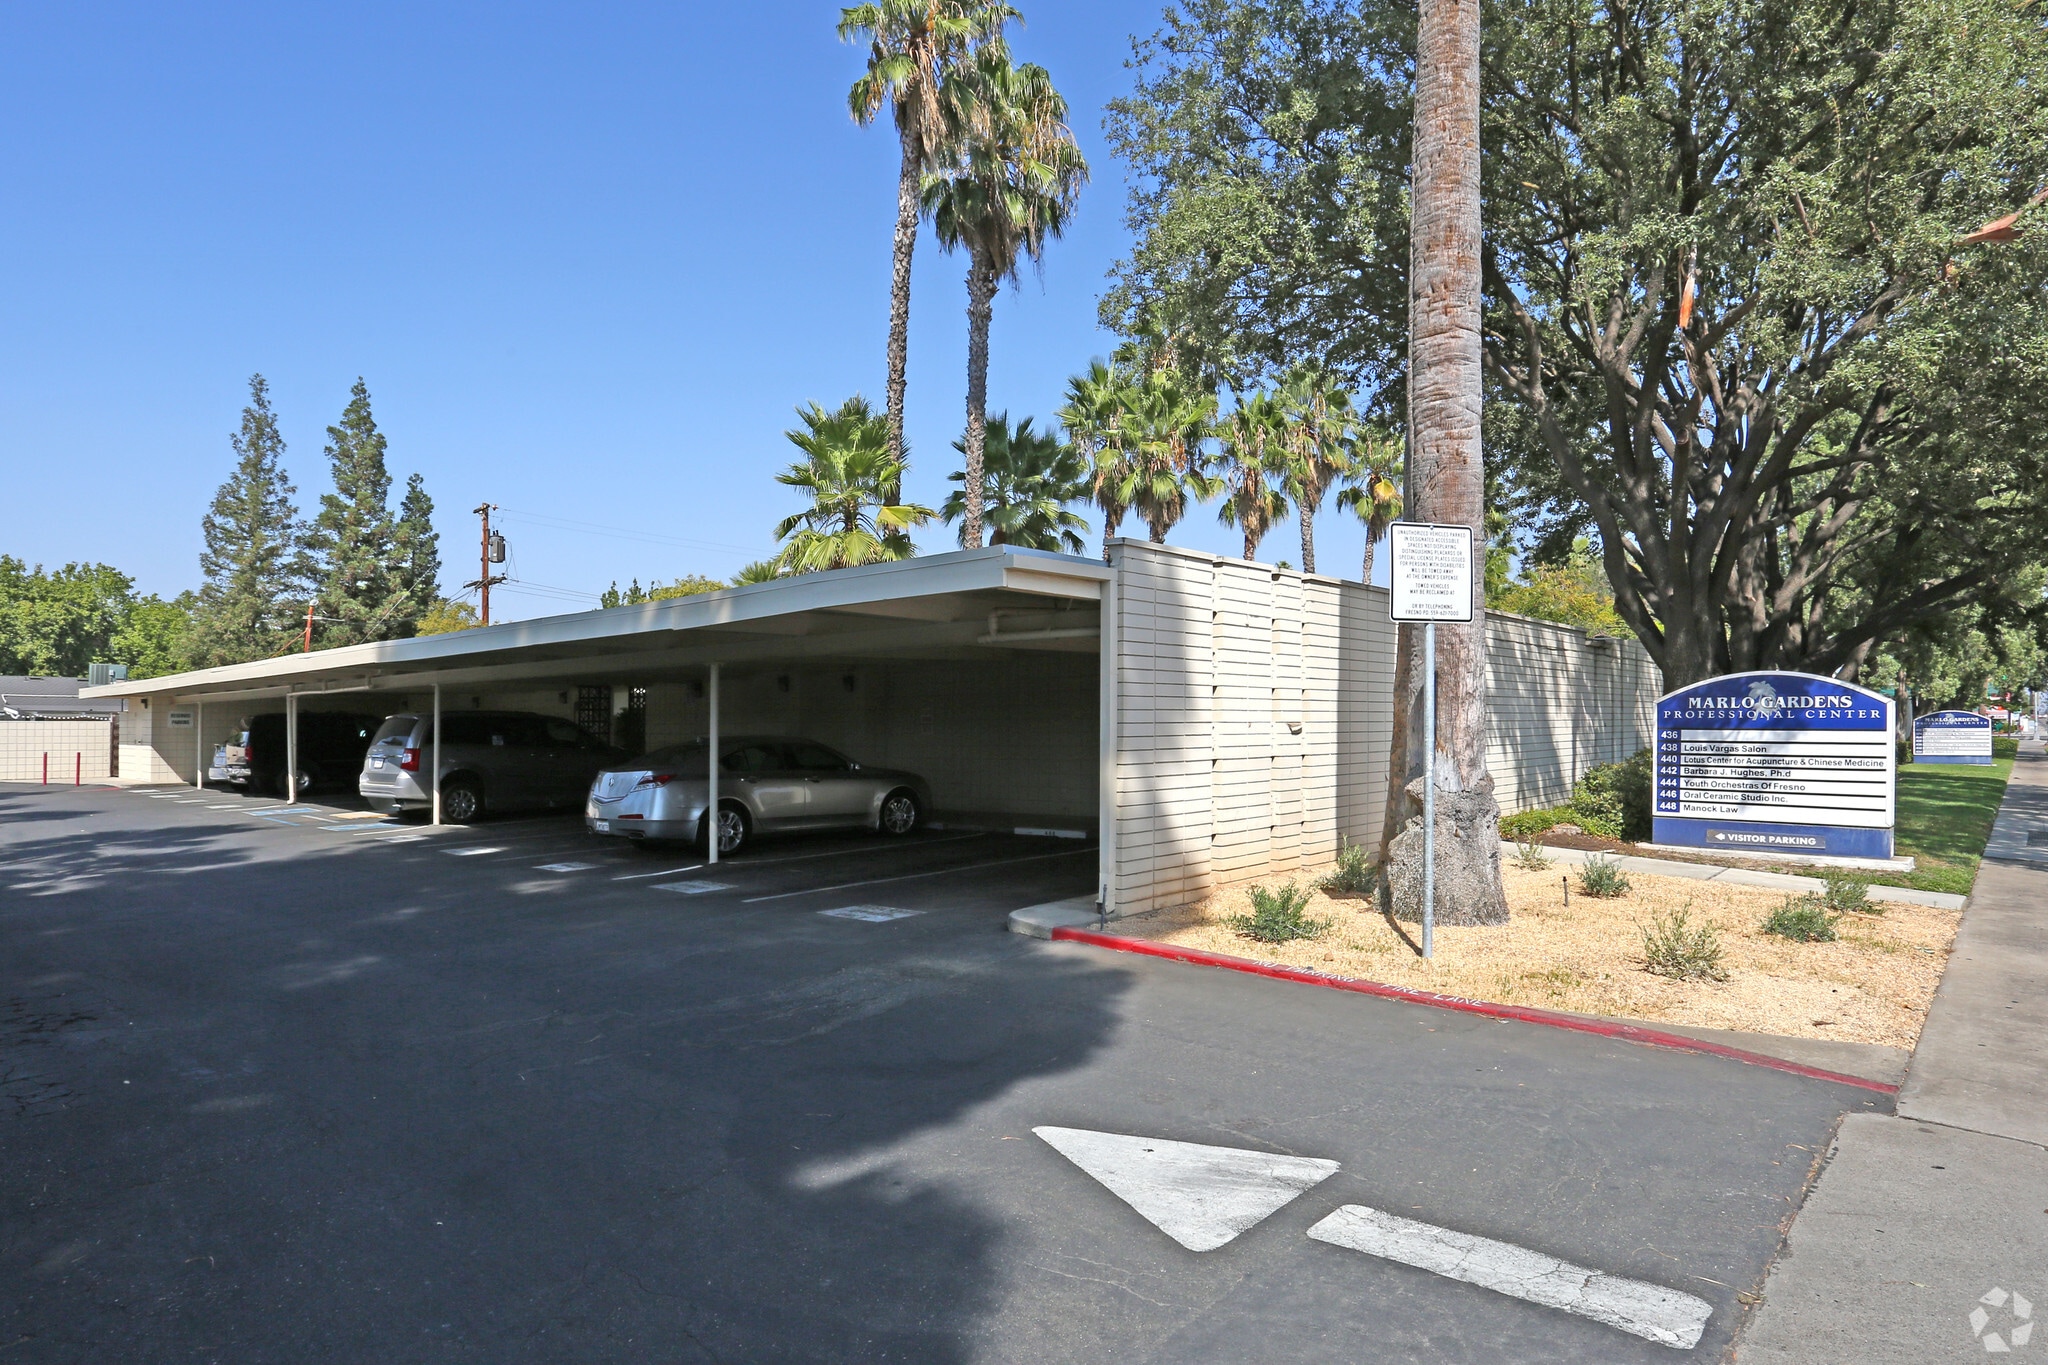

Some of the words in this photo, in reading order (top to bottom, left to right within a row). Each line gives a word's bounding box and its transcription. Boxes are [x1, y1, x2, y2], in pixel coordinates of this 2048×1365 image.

[1688, 696, 1755, 709] MARLO
[1761, 696, 1853, 709] GARDENS
[1664, 710, 1795, 719] PROFESSIONAL
[1805, 710, 1881, 719] CENTER
[1709, 745, 1739, 753] Vargas
[1746, 758, 1798, 766] Acupuncture
[1711, 781, 1759, 789] Orchestras
[1773, 783, 1806, 791] Fresno
[1741, 793, 1769, 802] Studio
[1728, 833, 1766, 843] VISITOR
[1769, 836, 1817, 846] PARKING
[1380, 984, 1429, 996] FIRE
[1433, 994, 1489, 1007] LANE
